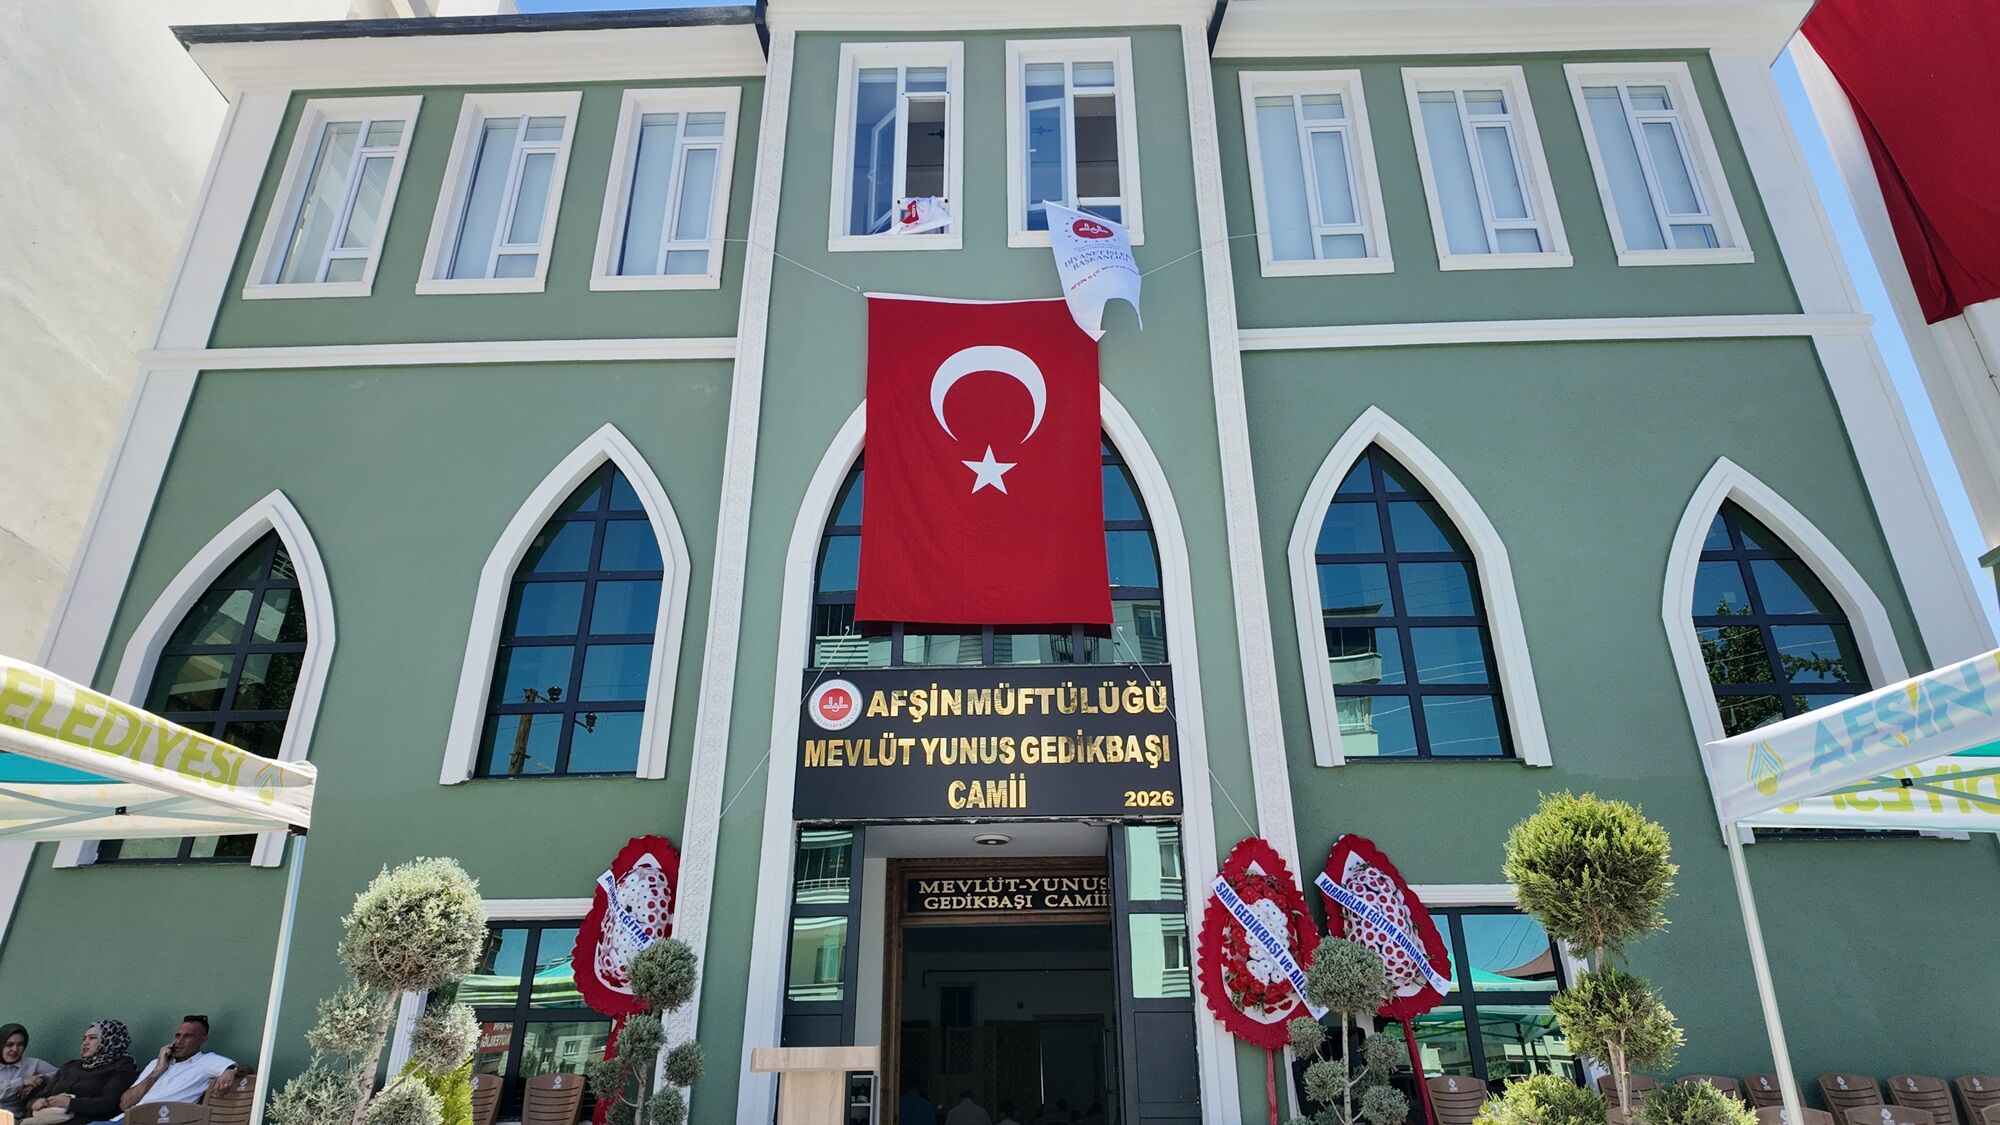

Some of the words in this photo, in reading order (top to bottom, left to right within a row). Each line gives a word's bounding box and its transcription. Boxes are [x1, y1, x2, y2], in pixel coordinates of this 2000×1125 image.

[866, 682, 962, 723] AFŞİN
[967, 680, 1167, 716] MÜFTÜLÜĞÜ
[804, 732, 916, 768] MEVLÜT
[921, 735, 1016, 767] YUNUS
[1020, 729, 1171, 769] GEDİKBAŞI
[947, 772, 1027, 810] CAMİİ
[1123, 790, 1175, 808] 2026
[924, 892, 1033, 910] GEDİKBAŞI
[1320, 878, 1368, 916] KARAOĞLAN
[1365, 907, 1397, 938] EĞİTİM
[1395, 931, 1434, 980] KURUMLARI
[1280, 955, 1293, 972] ve
